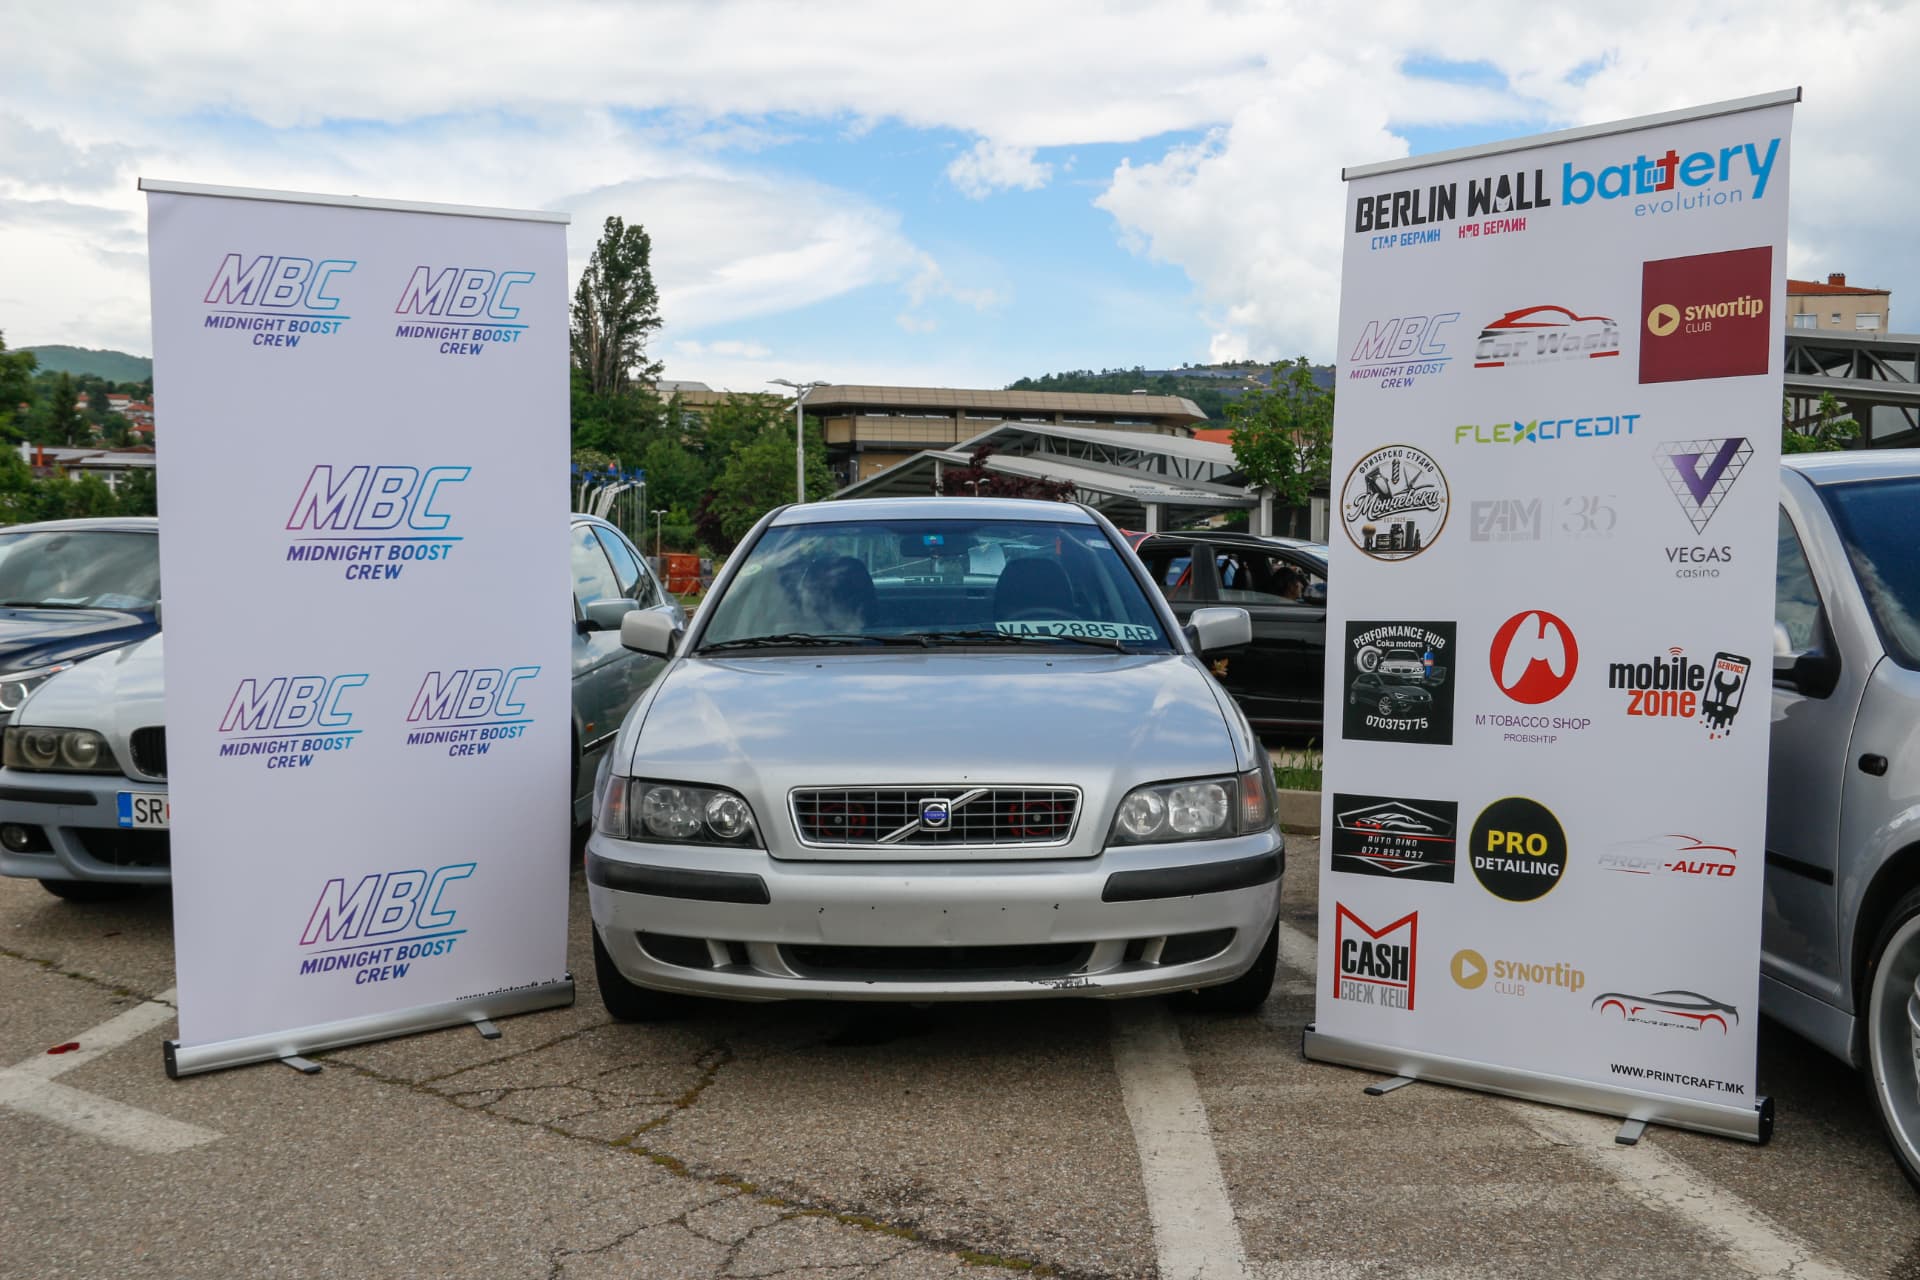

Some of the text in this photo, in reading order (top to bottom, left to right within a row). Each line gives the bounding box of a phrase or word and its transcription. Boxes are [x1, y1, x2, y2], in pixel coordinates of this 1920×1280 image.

[1562, 138, 1781, 206] battery
[1355, 169, 1551, 233] BERLIN WALL
[1635, 187, 1742, 218] evolution
[1483, 218, 1527, 235] БЕРЛИН
[1400, 229, 1441, 246] БЕРЛИН
[203, 253, 357, 310] MBC
[396, 266, 535, 319] MBC
[204, 316, 342, 335] MIDNIGHT BOOST
[396, 325, 521, 343] MIDNIGHT BOOST
[1685, 321, 1712, 334] CLUB
[253, 333, 300, 348] CREW
[1350, 312, 1461, 361] MBC
[440, 342, 483, 356] CREW
[1350, 363, 1446, 379] MIDNIGHT BOOST
[1381, 377, 1415, 389] CREW
[285, 465, 472, 530] MBC
[286, 544, 452, 561] MIDNIGHT BOOST
[1665, 546, 1732, 563] VEGAS
[345, 564, 403, 580] CREW
[1676, 565, 1720, 578] casino
[1052, 623, 1119, 640] 2885
[1353, 626, 1446, 649] PERFORMANCE HUB
[1396, 640, 1423, 648] motors
[1608, 656, 1705, 691] mobile
[1717, 660, 1745, 674] SERVICE
[218, 673, 369, 732] MBC
[406, 666, 541, 722] MBC
[1627, 690, 1696, 718] zone
[1366, 715, 1428, 730] 070375775
[1475, 714, 1591, 730] M TOBACCO SHOP
[407, 725, 526, 745] MIDNIGHT BOOST
[1504, 733, 1557, 744] PROBISHTIP
[219, 736, 354, 757] MIDNIGHT BOOST
[449, 742, 490, 757] CREW
[267, 754, 313, 769] CREW
[135, 798, 162, 824] SR
[1487, 829, 1549, 857] PRO
[1474, 856, 1560, 877] DETAILING
[299, 863, 477, 946] MBC
[300, 938, 456, 976] MIDNIGHT BOOST
[1341, 938, 1409, 982] CASH
[355, 963, 410, 985] CREW
[1341, 980, 1408, 1009] СВЕЖ КЕШ
[1495, 981, 1526, 997] CLUB
[1611, 1063, 1745, 1094] WWW.PRINTCRAFT.MK
